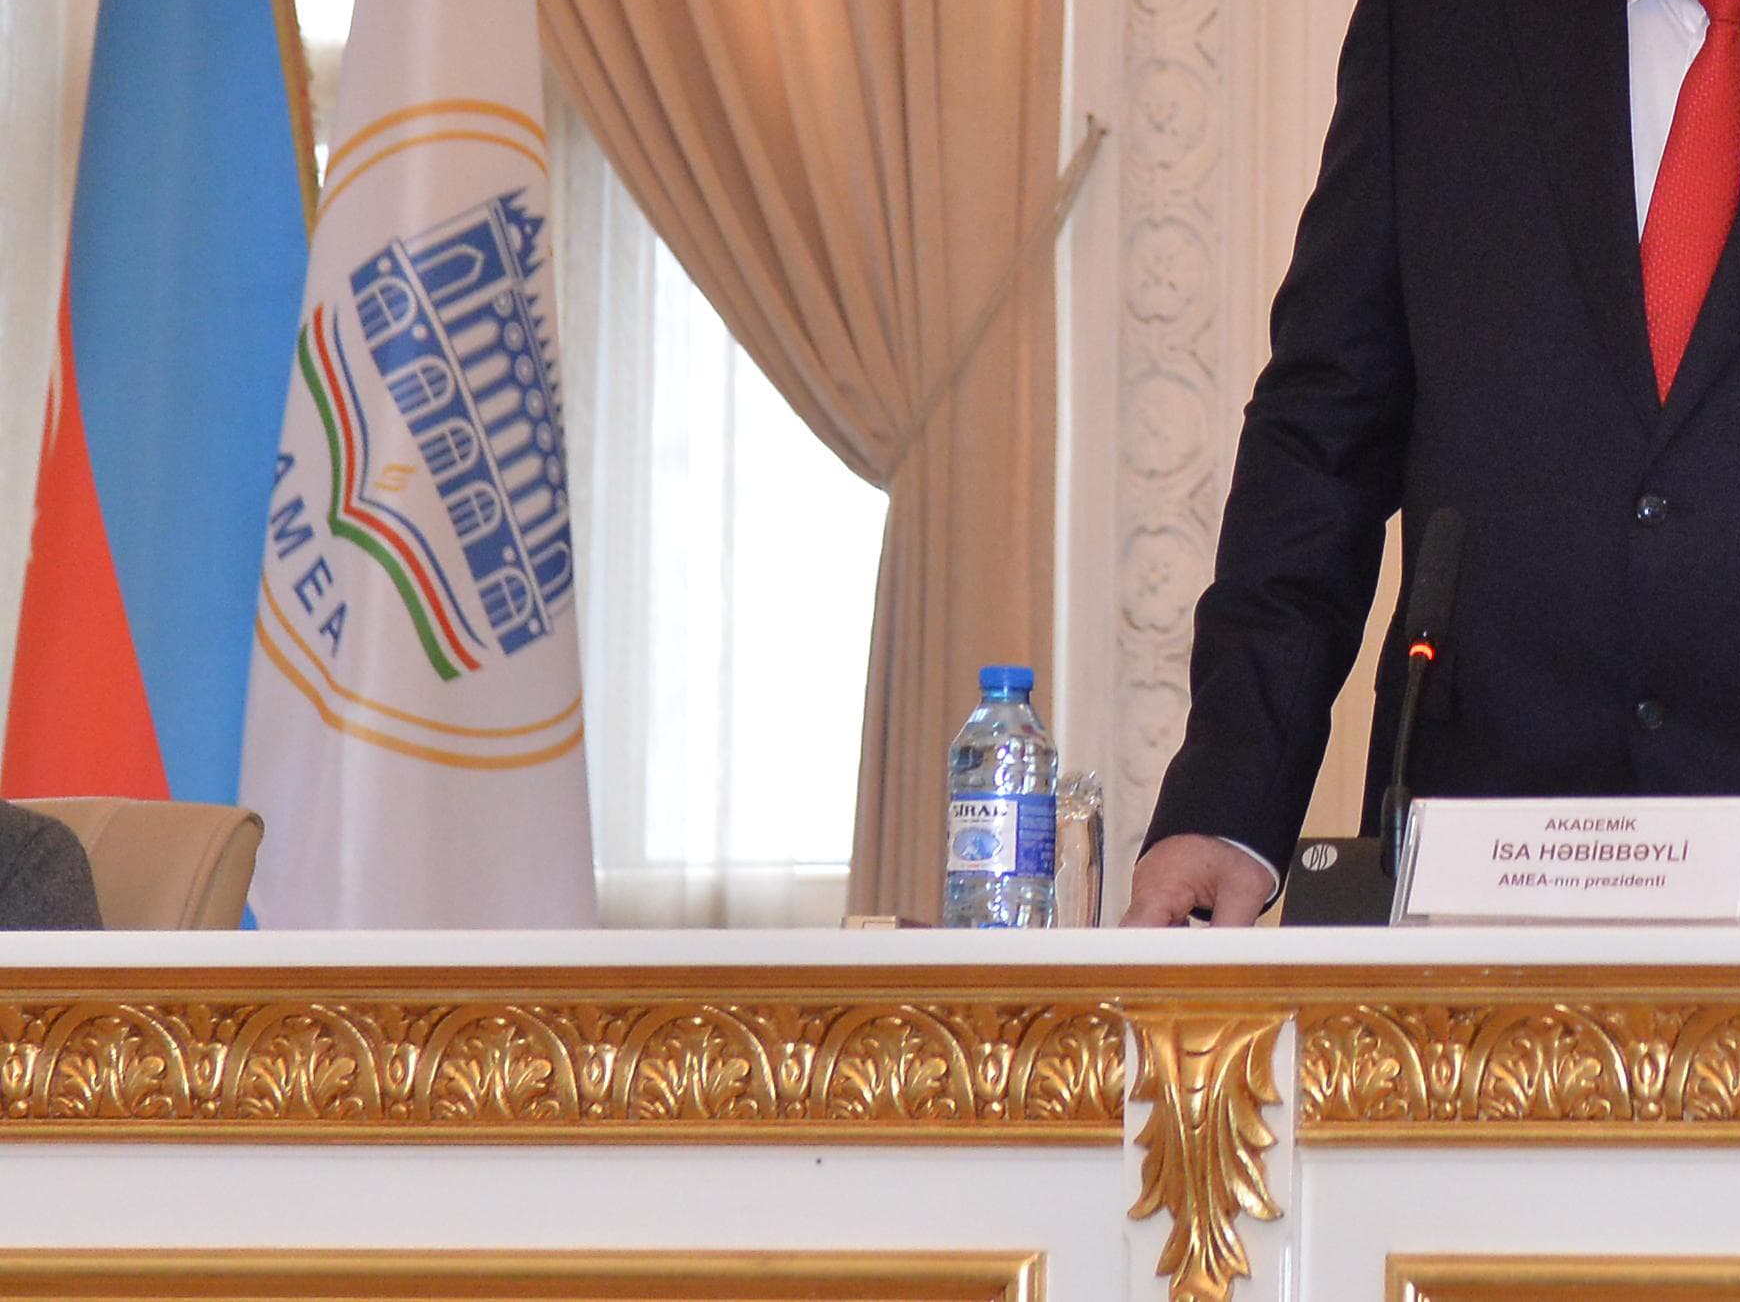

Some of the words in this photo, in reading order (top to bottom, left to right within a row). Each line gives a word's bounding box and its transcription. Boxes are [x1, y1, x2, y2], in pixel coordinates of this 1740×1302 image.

[1544, 816, 1637, 832] AKADEMİK
[1492, 839, 1531, 861] İSA
[1538, 839, 1689, 862] HƏBİBBƏYLİ
[1584, 874, 1666, 890] prezidenti
